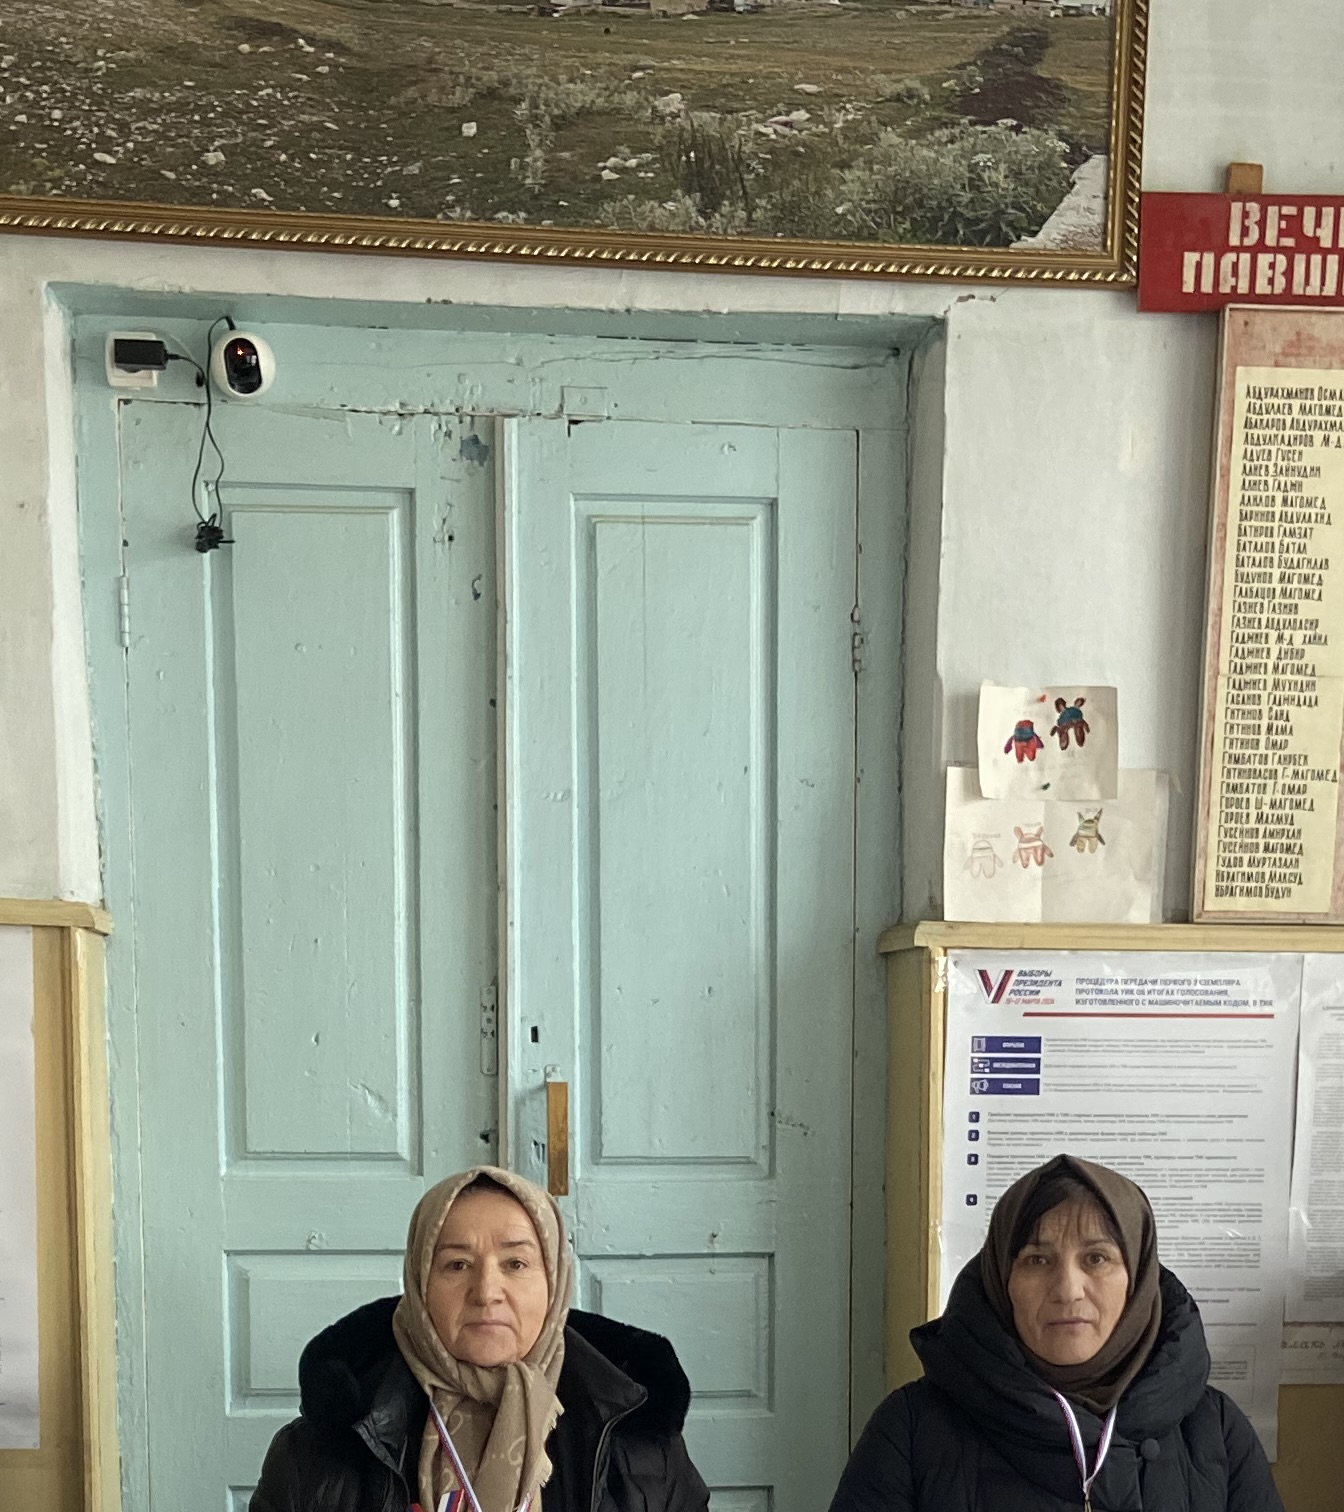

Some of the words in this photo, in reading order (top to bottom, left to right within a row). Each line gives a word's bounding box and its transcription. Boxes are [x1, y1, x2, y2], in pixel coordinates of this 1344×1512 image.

[1298, 403, 1343, 417] МАГОМЕД
[1281, 495, 1326, 510] МАГОМЕД
[1277, 525, 1314, 539] ГАМЗАТ
[1278, 571, 1323, 586] МАГОМЕД
[1279, 586, 1322, 601] МАГОМЕД
[1272, 661, 1316, 676] МАГОМЕД
[1263, 842, 1303, 856] МАГОМЕД
